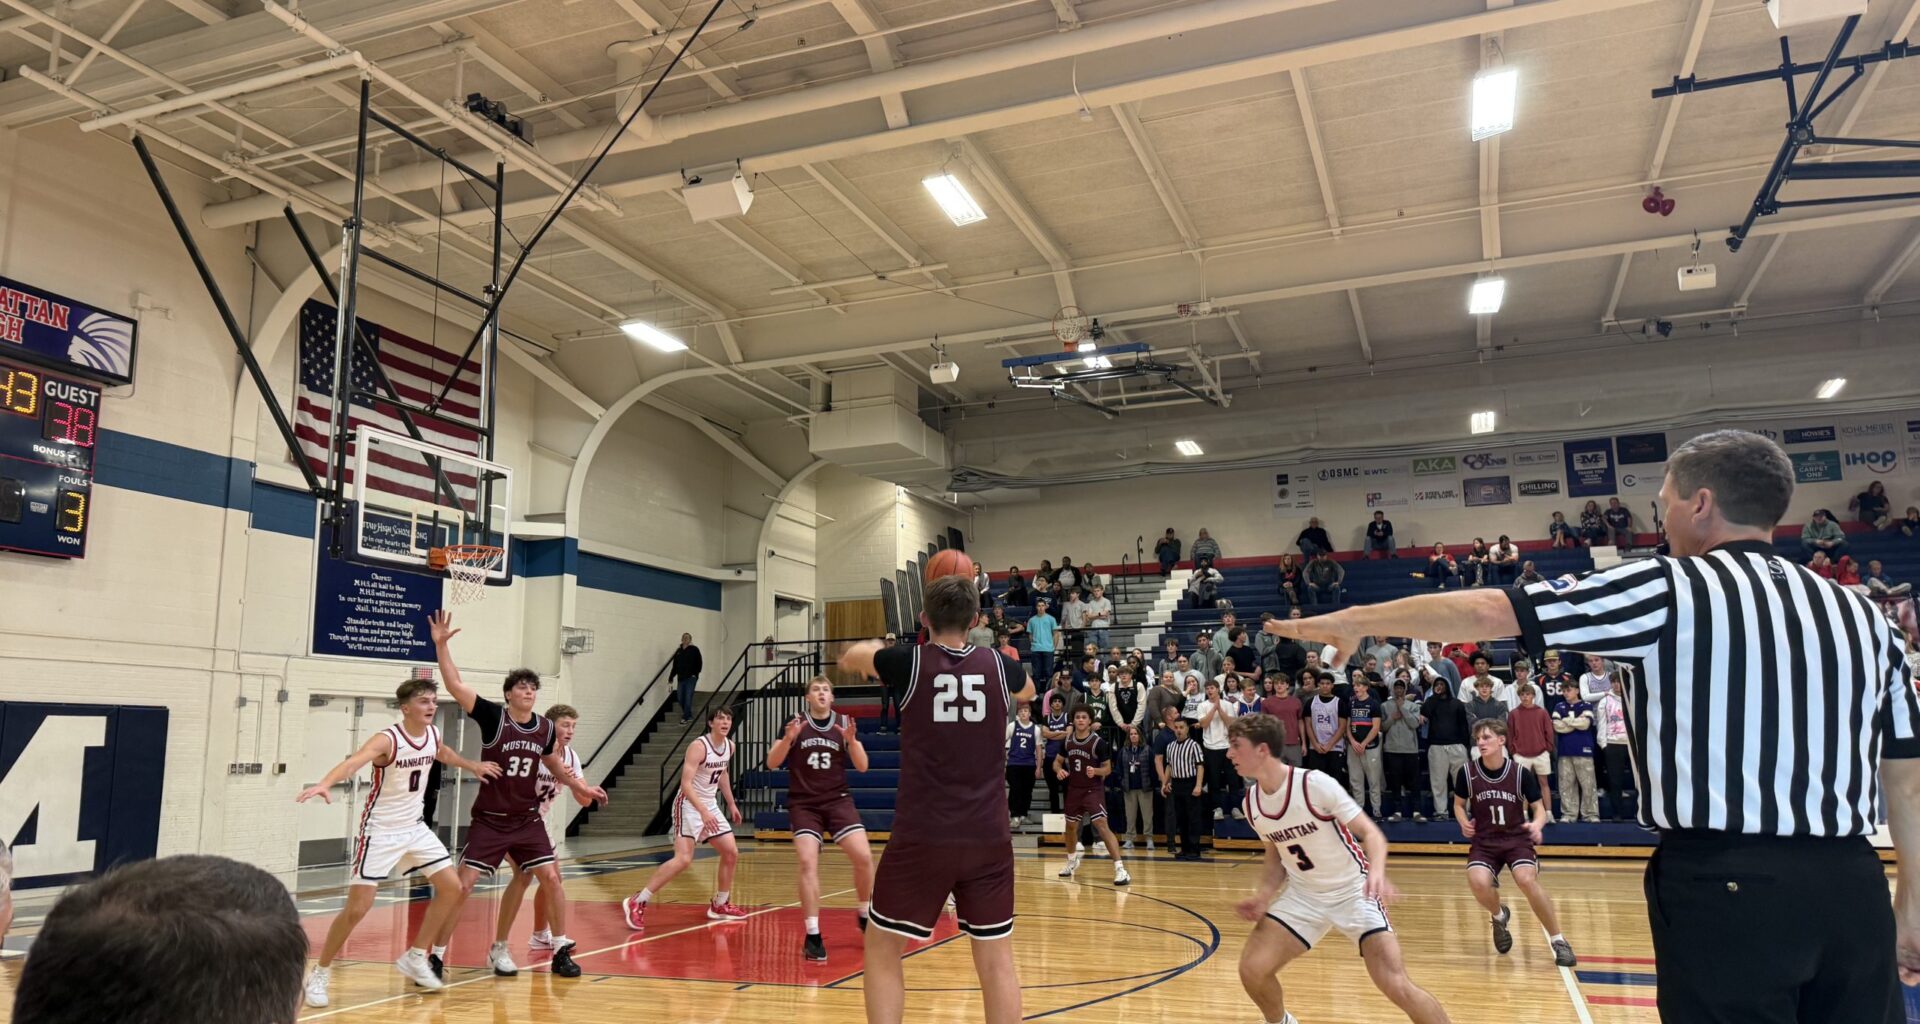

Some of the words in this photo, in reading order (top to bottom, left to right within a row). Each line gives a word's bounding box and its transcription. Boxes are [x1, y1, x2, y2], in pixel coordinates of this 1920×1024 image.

[44, 381, 99, 407] GUEST
[52, 401, 95, 447] 38
[33, 444, 65, 457] BONUS
[1416, 458, 1454, 472] AKA
[1799, 465, 1828, 473] CARPET
[1329, 467, 1359, 478] OSMC
[58, 474, 88, 487] FOULS
[1520, 482, 1557, 491] SHILLING
[64, 491, 85, 532] 3
[57, 535, 81, 546] WON
[357, 596, 375, 605] hearts
[933, 673, 987, 722] 25
[1317, 714, 1331, 724] 24
[1020, 738, 1027, 748] 2
[506, 756, 533, 777] 33
[807, 752, 831, 769] 43
[1075, 759, 1082, 772] 3
[409, 770, 422, 792] 0
[1476, 790, 1516, 803] MUSTANGS
[1489, 805, 1506, 825] 11
[1287, 844, 1315, 871] 3
